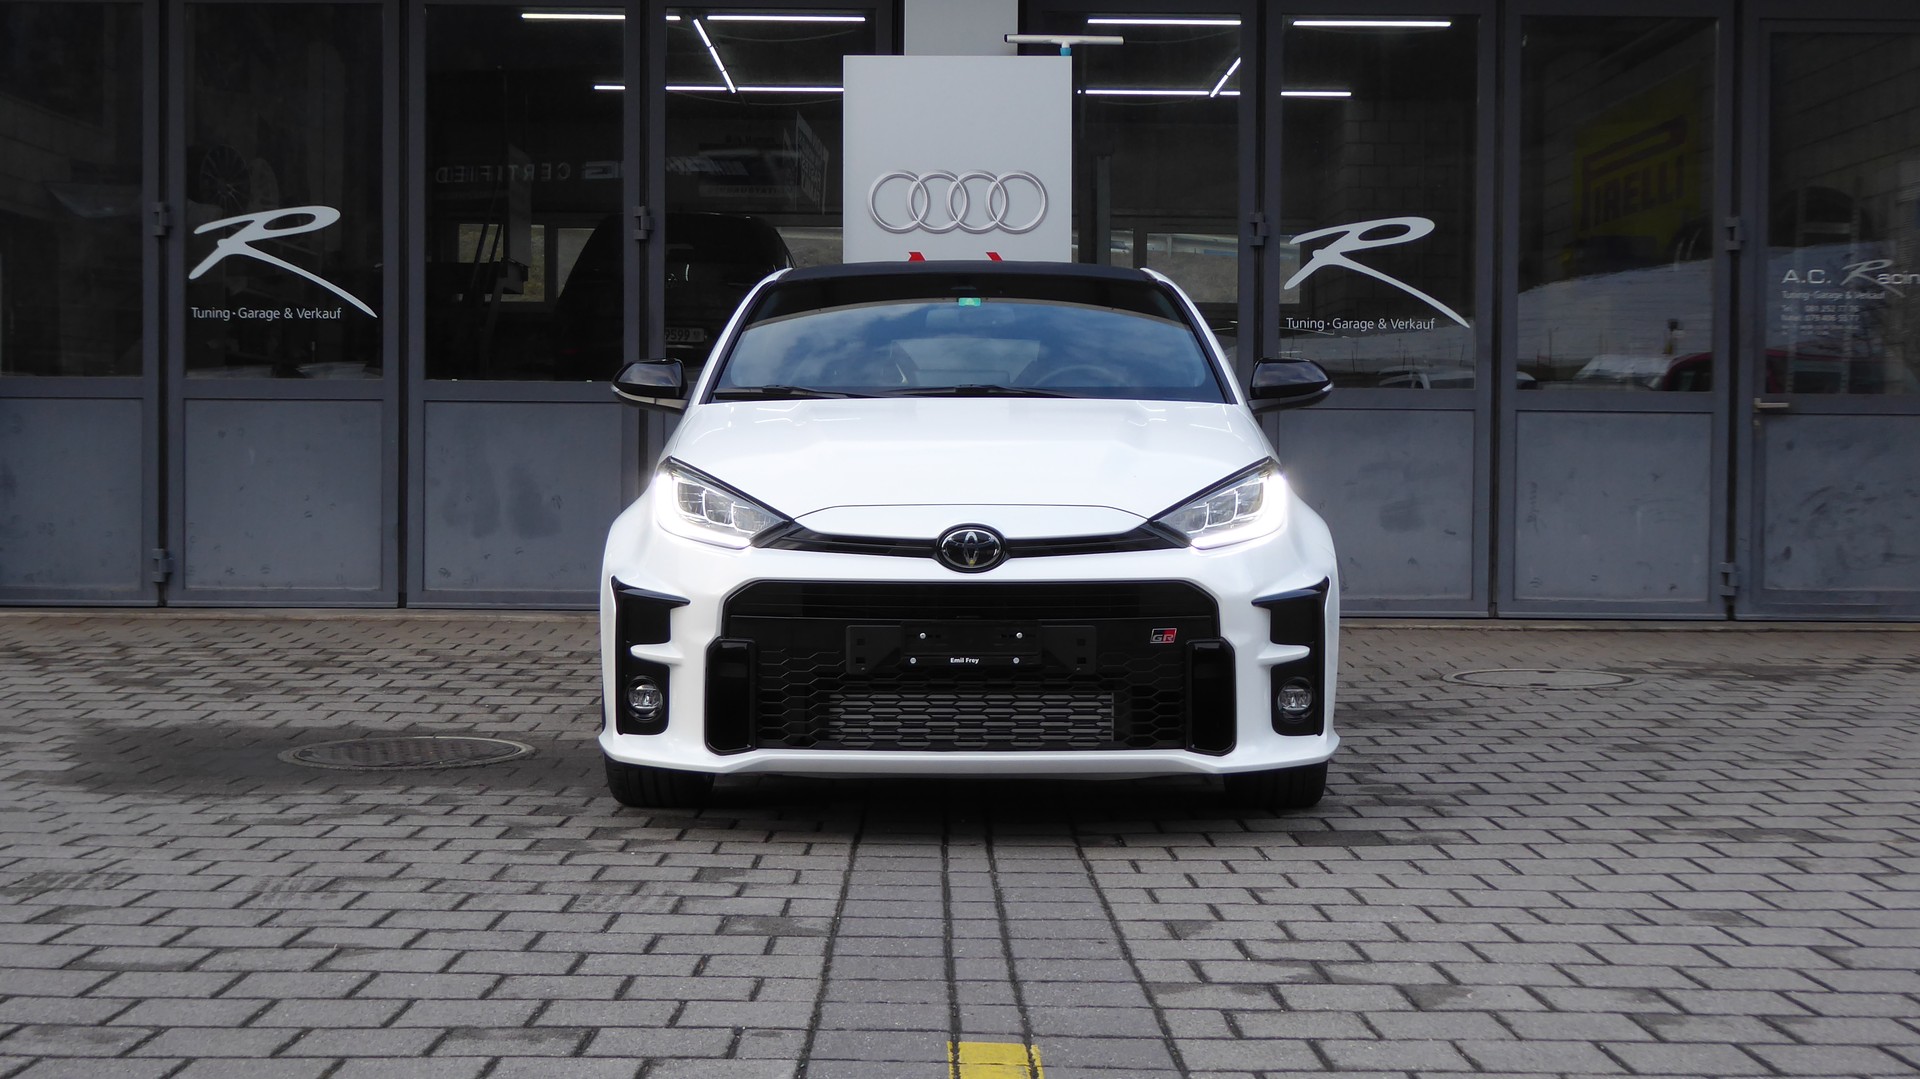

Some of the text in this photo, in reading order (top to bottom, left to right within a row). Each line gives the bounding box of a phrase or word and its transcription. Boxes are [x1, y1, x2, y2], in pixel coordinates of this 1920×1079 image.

[1580, 113, 1688, 232] PIRELLI
[189, 205, 378, 318] R
[1284, 216, 1470, 328] R
[1781, 269, 1832, 284] A.C.
[191, 307, 342, 321] Tuning Garage & Verkauf
[1286, 317, 1436, 331] Tuning Garage & Verkauf
[965, 657, 980, 665] Frey
